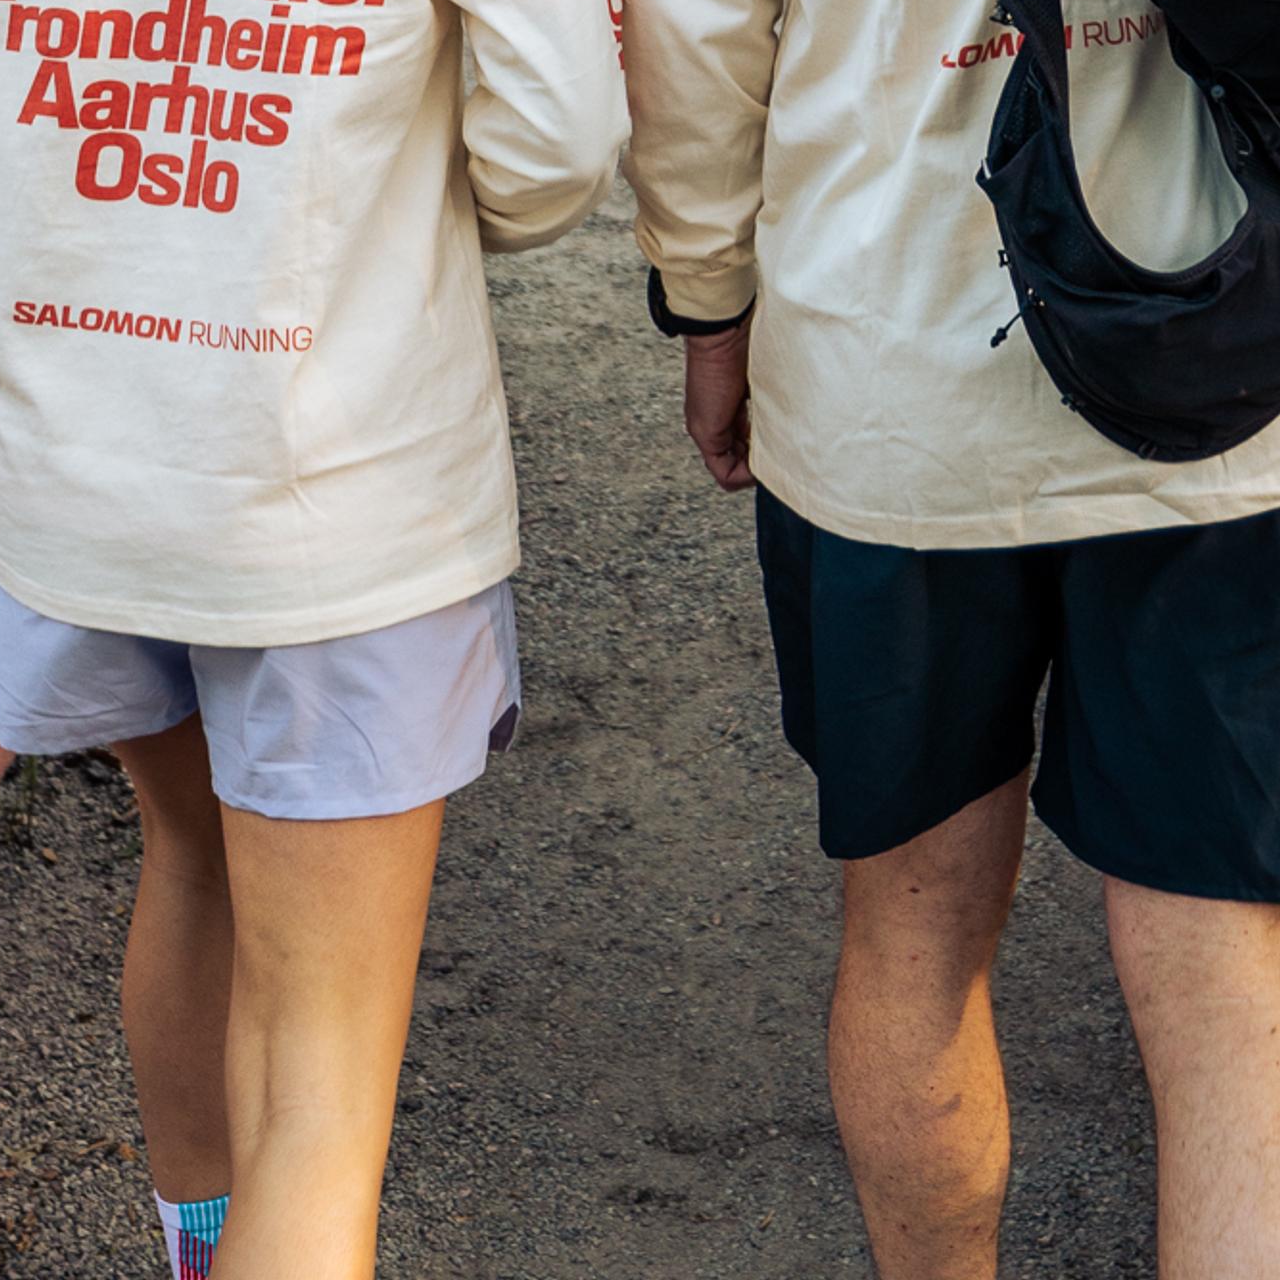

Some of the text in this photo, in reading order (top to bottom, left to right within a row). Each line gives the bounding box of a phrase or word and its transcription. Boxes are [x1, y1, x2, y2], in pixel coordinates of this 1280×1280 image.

[17, 60, 293, 147] Aarhus
[75, 132, 240, 214] Oslo
[12, 299, 314, 354] SALOMON RUNNING
